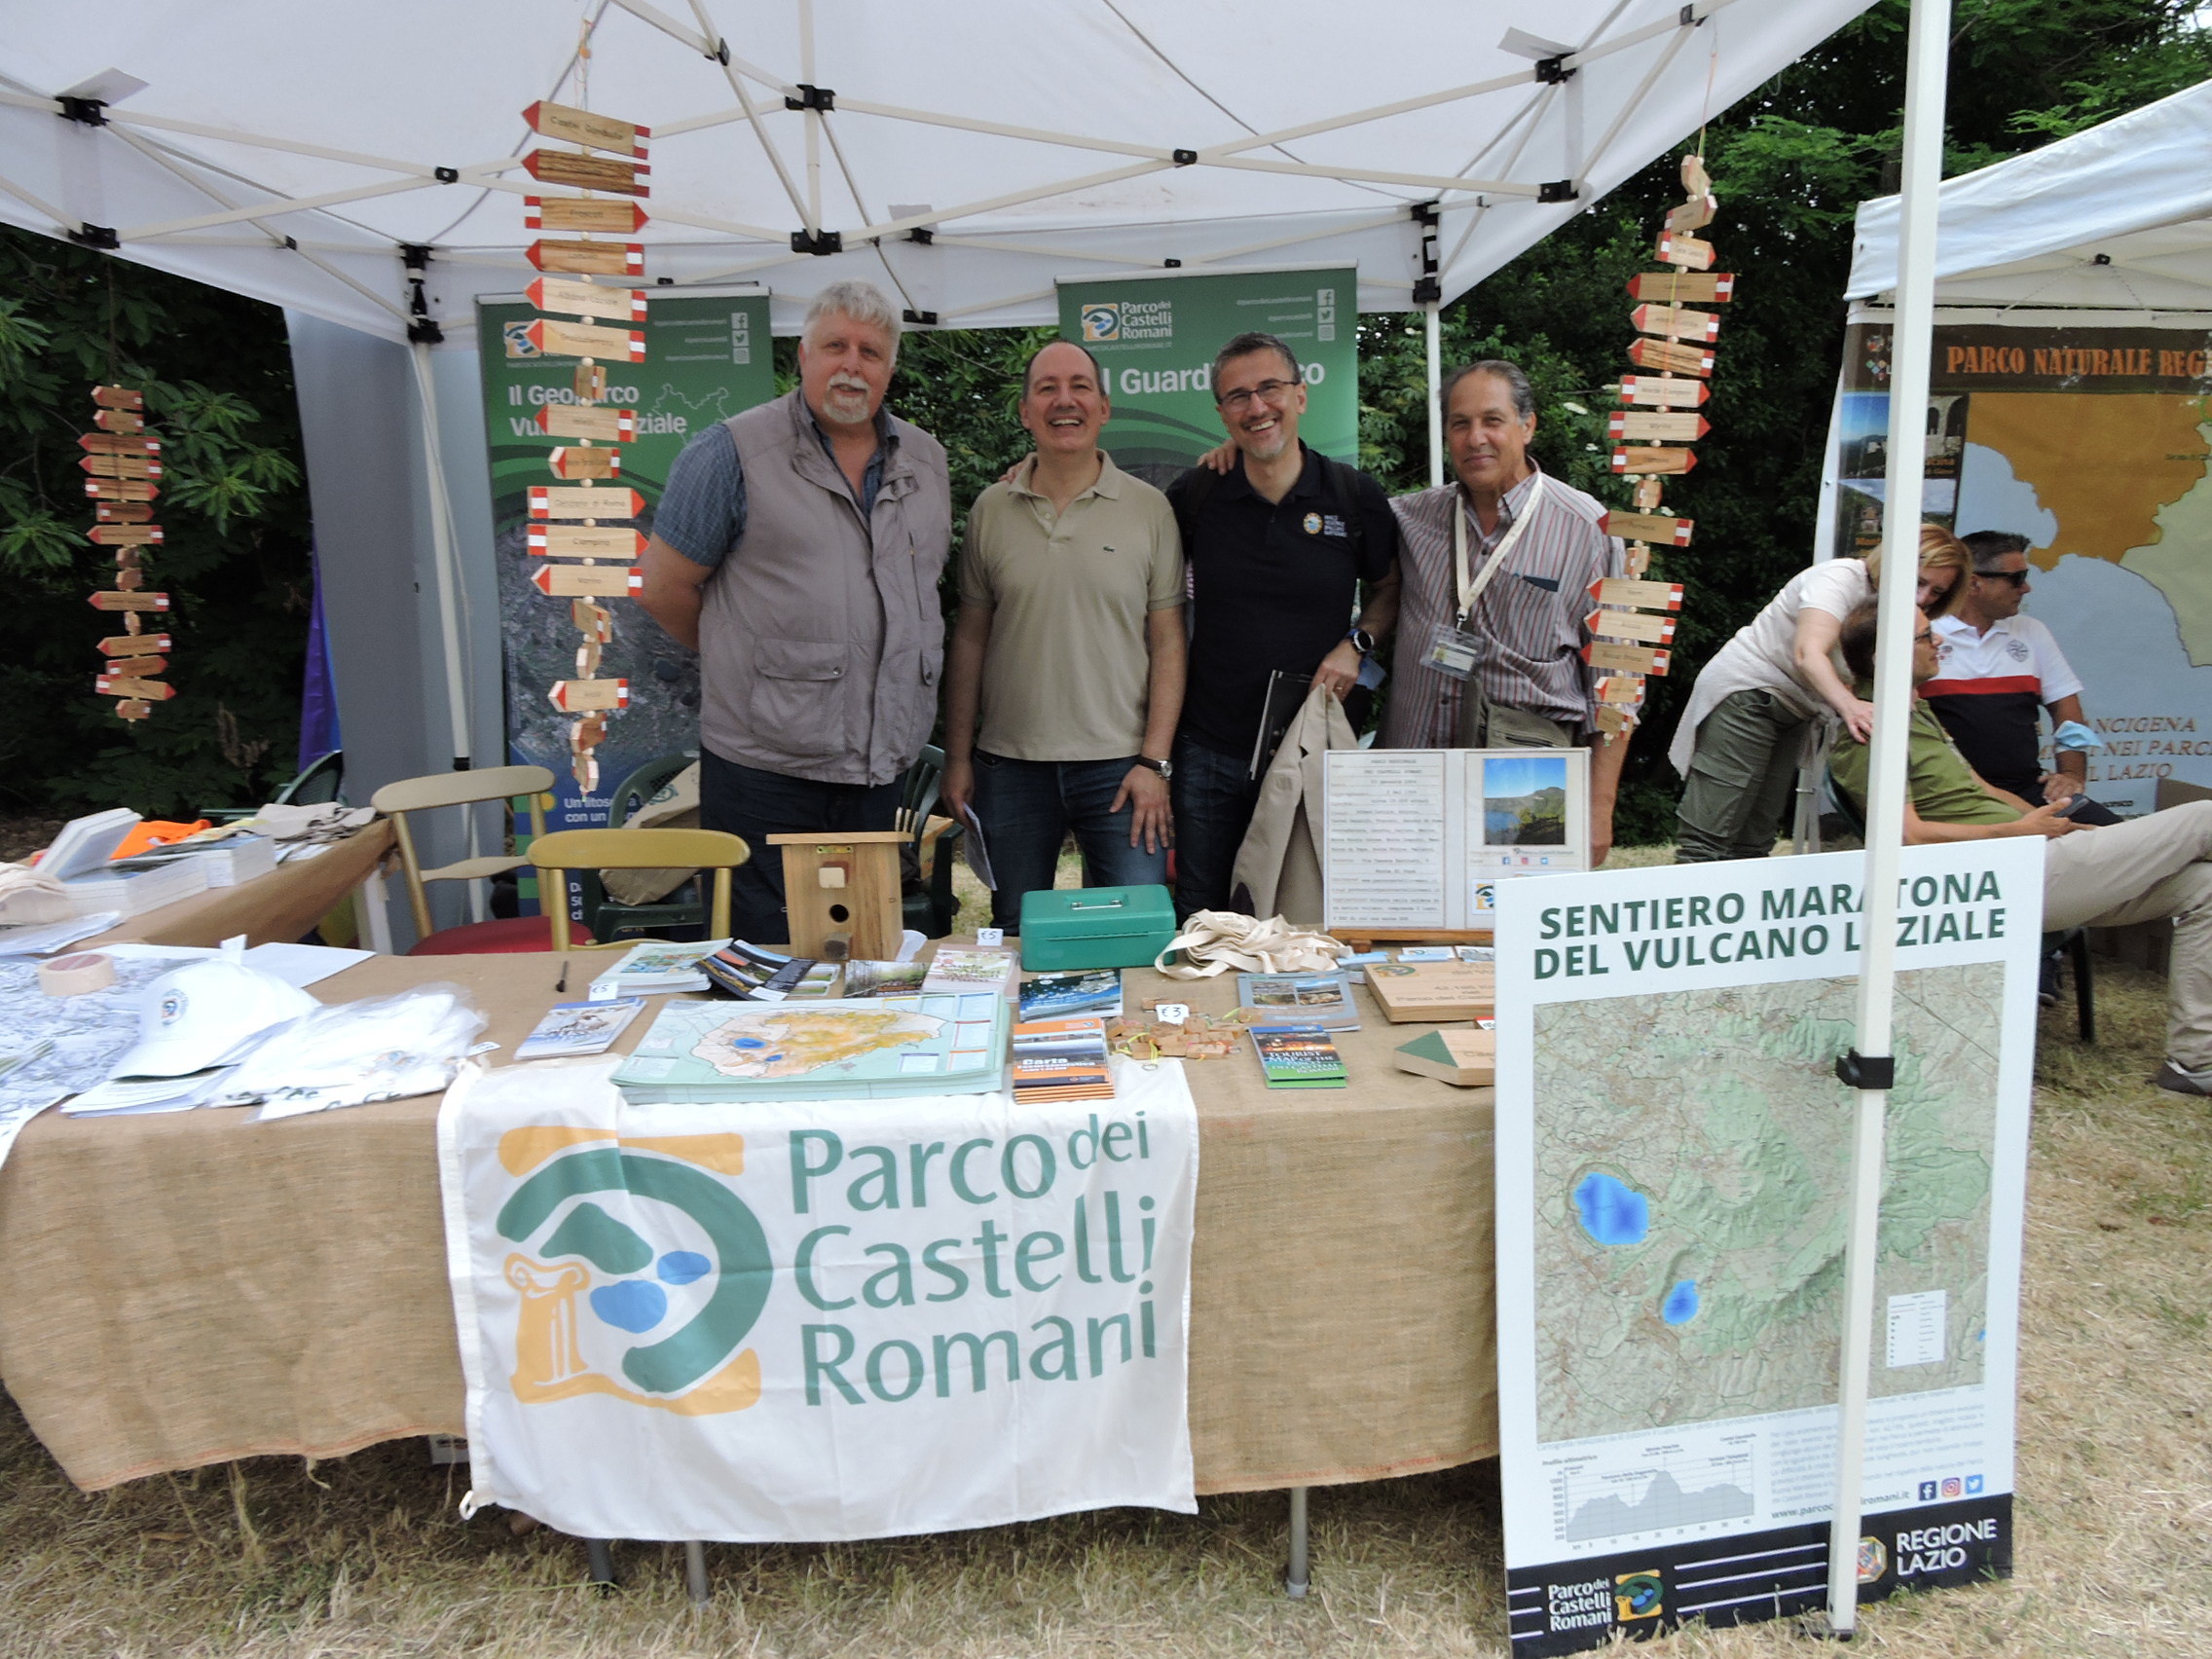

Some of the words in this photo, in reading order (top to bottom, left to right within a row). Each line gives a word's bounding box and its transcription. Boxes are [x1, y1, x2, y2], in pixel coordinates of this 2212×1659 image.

[1121, 302, 1158, 313] Parco
[1158, 300, 1171, 310] dei
[1122, 312, 1171, 326] Castelli
[1123, 325, 1172, 339] Romani
[1946, 346, 2026, 374] PARCO
[2033, 348, 2151, 376] NATURALE
[509, 386, 523, 406] Il
[2107, 761, 2173, 781] LAZIO
[1539, 893, 1745, 940] SENTIERO
[1533, 945, 1608, 979] DEL
[1623, 924, 1828, 971] VULCANO
[1844, 907, 2007, 952] LZIALE
[1161, 1007, 1182, 1017] €3
[788, 1128, 1056, 1215] Parco
[1068, 1110, 1150, 1170] dei
[793, 1190, 1157, 1311] Castelli
[800, 1280, 1157, 1407] Romani
[1897, 1517, 1998, 1553] REGIONE
[1897, 1546, 1968, 1576] LAZIO
[1547, 1582, 1594, 1601] Parco
[1593, 1577, 1610, 1590] dei
[1549, 1591, 1611, 1616] Castelli
[1550, 1607, 1612, 1633] Romani
